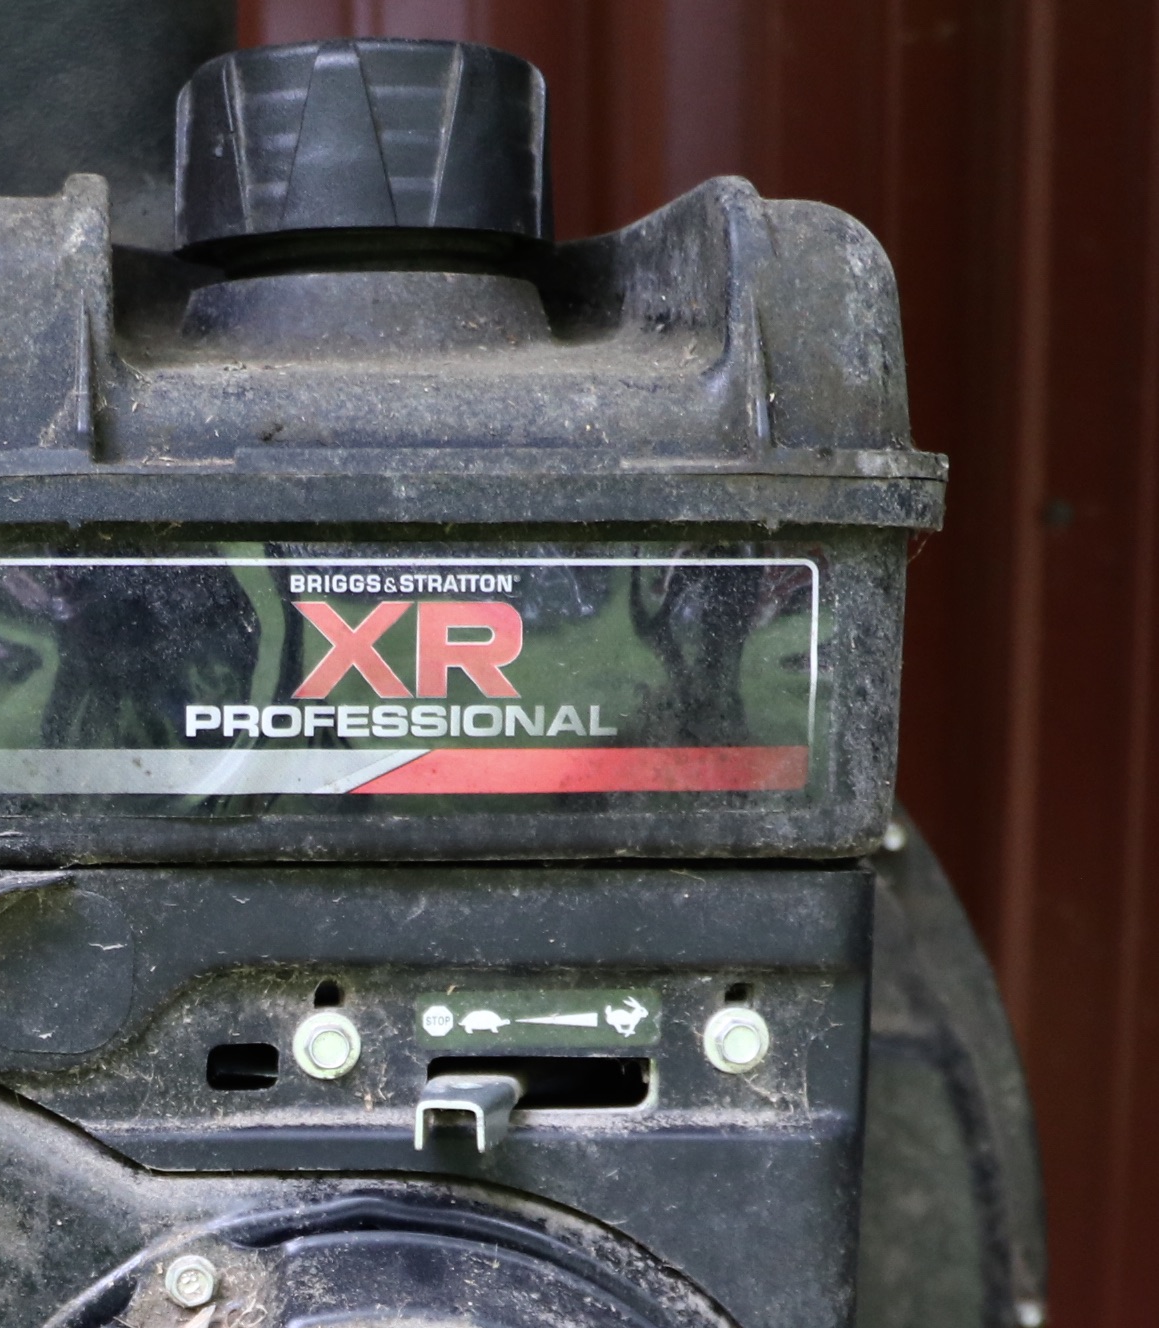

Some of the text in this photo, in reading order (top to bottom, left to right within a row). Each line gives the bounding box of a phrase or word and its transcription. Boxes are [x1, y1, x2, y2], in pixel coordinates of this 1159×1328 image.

[291, 601, 524, 700] XR
[185, 705, 618, 738] PROFESSIONAL
[426, 1016, 451, 1026] STOP
